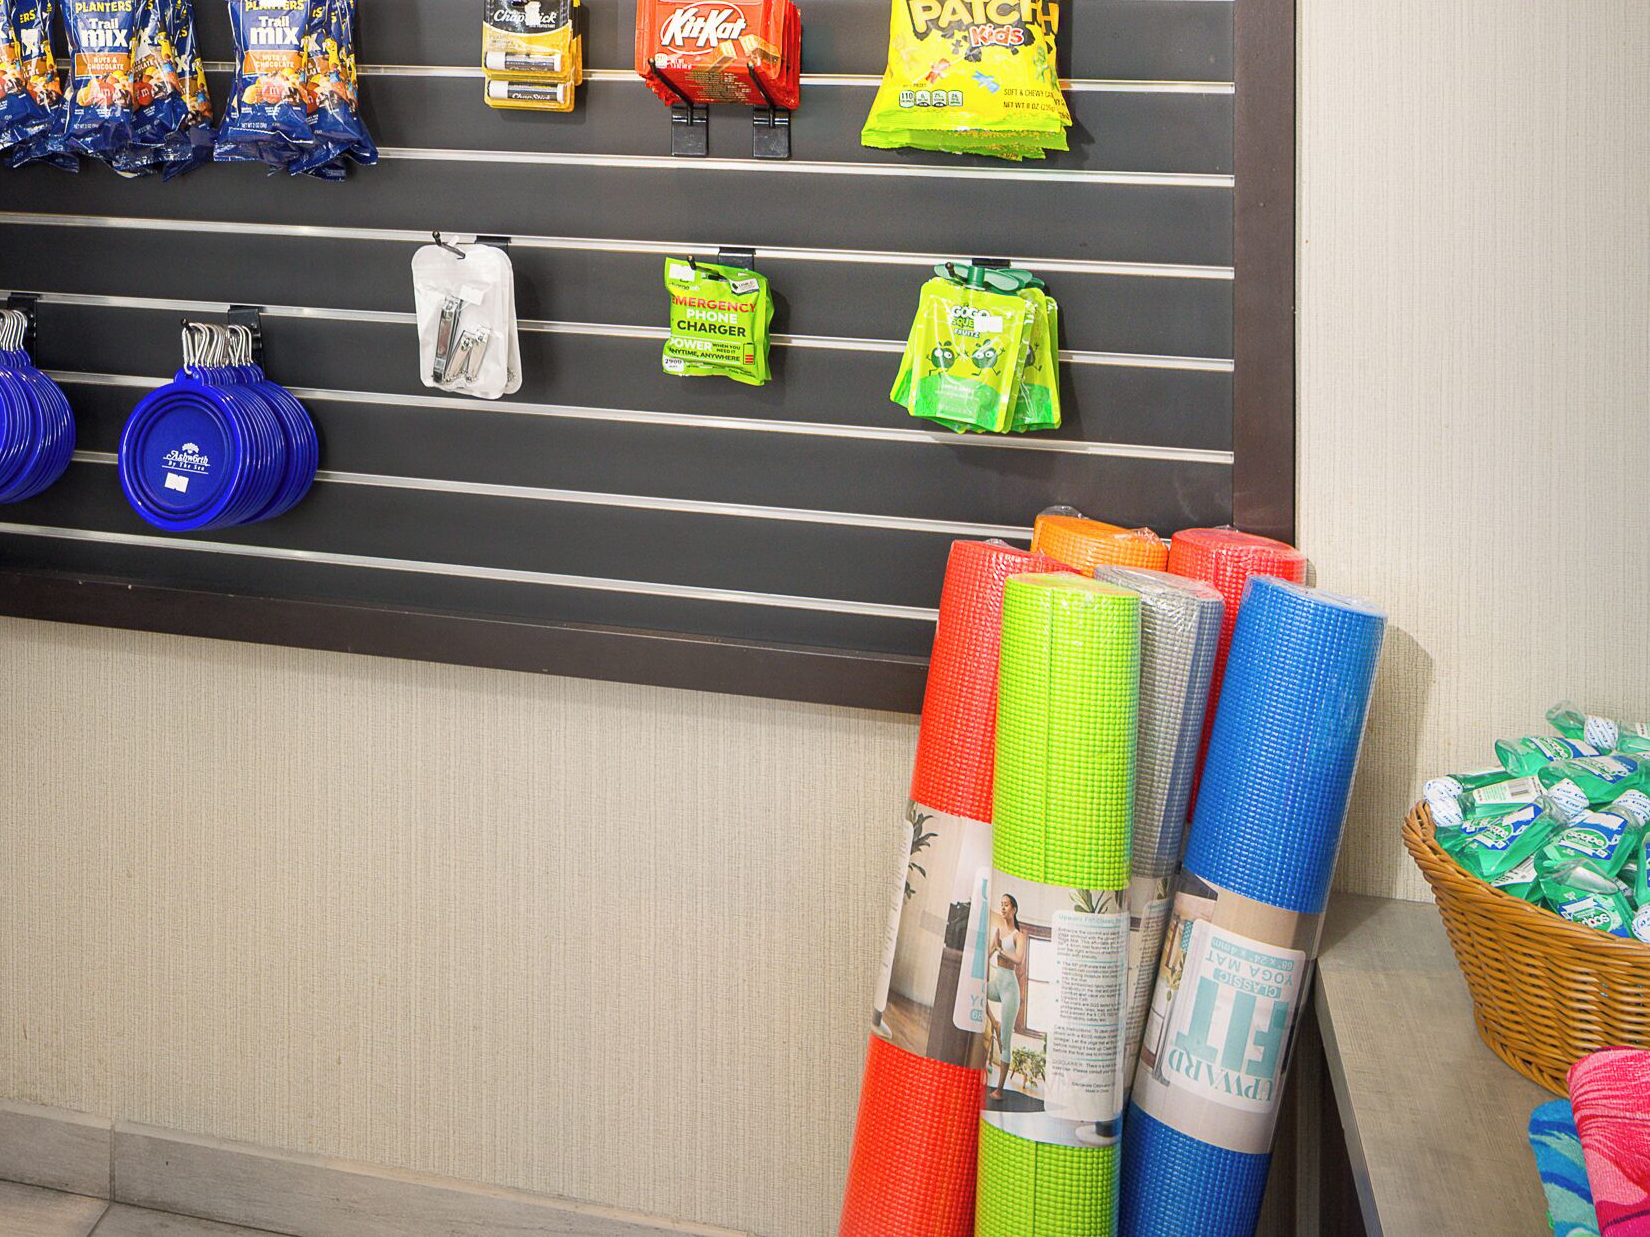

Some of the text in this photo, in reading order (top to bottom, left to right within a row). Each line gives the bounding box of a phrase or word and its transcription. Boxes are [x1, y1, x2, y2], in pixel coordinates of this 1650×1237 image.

[75, 0, 133, 14] PLANTERS
[90, 17, 119, 29] Trail
[259, 16, 289, 28] Trail
[81, 28, 128, 47] mix
[250, 27, 300, 45] mix
[968, 23, 1025, 47] Kids
[88, 63, 124, 71] CHOCOLATE
[256, 61, 294, 69] CHOCOLATE
[901, 91, 914, 100] 110
[1003, 88, 1044, 98] SOFT CHEWY
[1002, 101, 1025, 109] NET WT
[686, 309, 738, 325] PHONE
[677, 320, 747, 337] CHARGER
[700, 352, 741, 362] ANYWHERE
[165, 449, 209, 466] Ashworth
[168, 460, 177, 468] By
[179, 461, 191, 469] The
[1567, 831, 1606, 847] scope
[1212, 937, 1239, 957] 4mm
[1205, 949, 1293, 986] YOGA MAT
[1217, 970, 1279, 998] CLASSIC
[1175, 975, 1290, 1080] FIT
[1167, 1048, 1273, 1102] UPWARD
